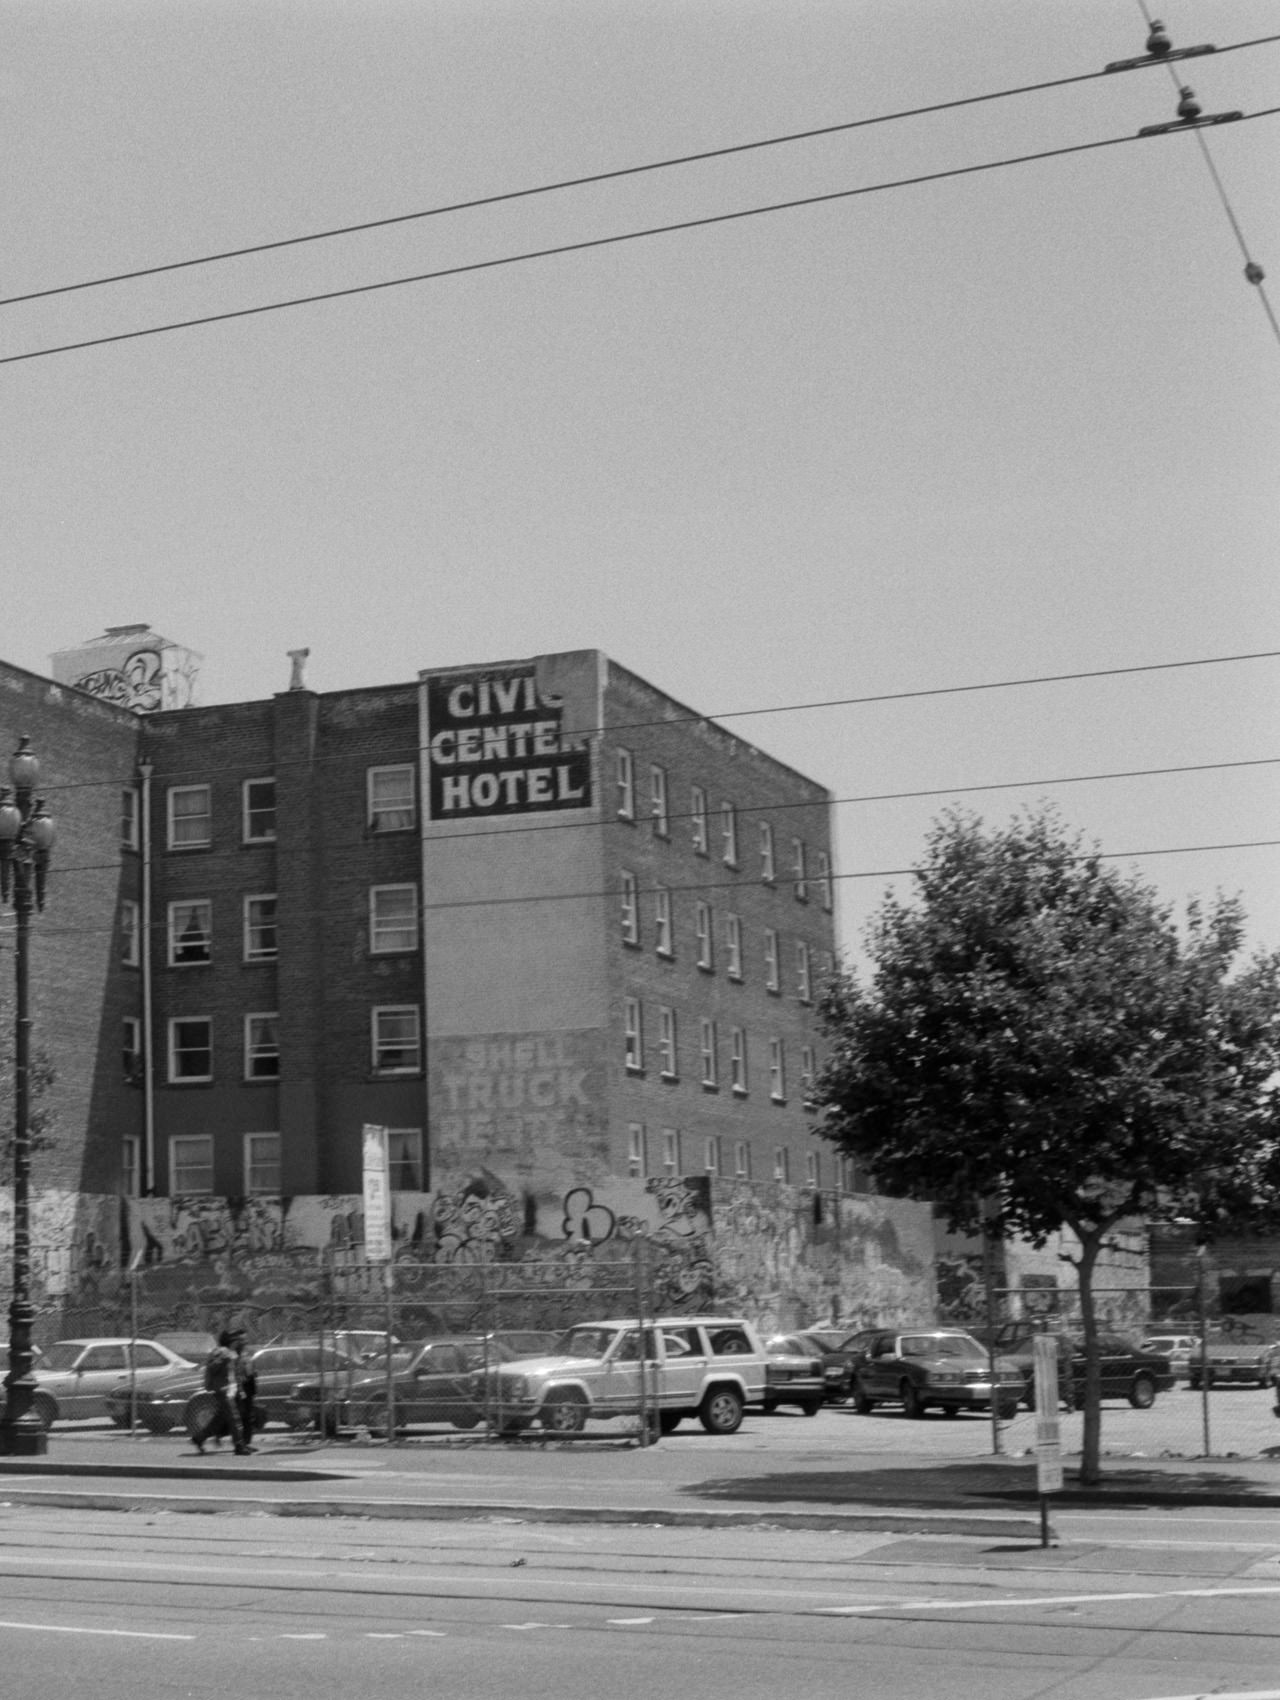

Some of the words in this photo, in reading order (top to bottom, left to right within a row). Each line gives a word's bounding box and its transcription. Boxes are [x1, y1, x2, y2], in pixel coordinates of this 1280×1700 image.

[431, 720, 588, 764] CENTE
[442, 766, 584, 810] HOTEL
[444, 1071, 590, 1110] TRUCK
